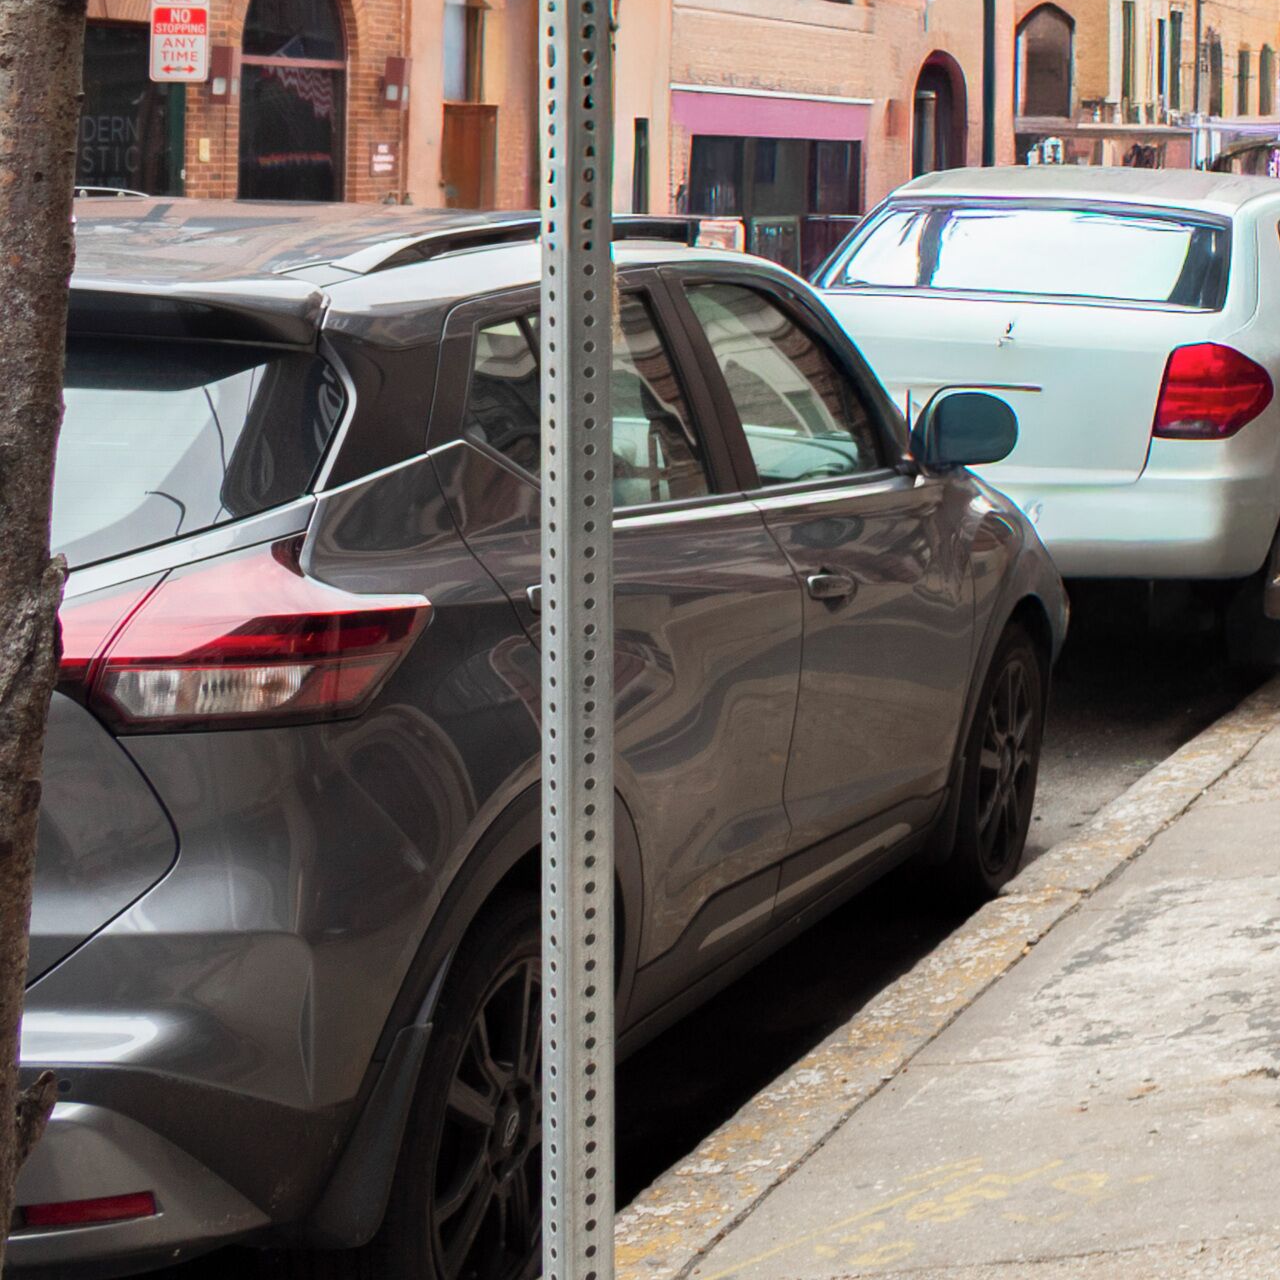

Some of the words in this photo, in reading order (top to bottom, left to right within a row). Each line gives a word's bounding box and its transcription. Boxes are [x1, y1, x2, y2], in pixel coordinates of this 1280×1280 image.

[170, 8, 192, 23] NO
[155, 22, 206, 35] STOPPING
[163, 37, 197, 49] ANY
[161, 50, 199, 63] TIME
[80, 115, 140, 143] DERN
[80, 145, 140, 173] STIC
